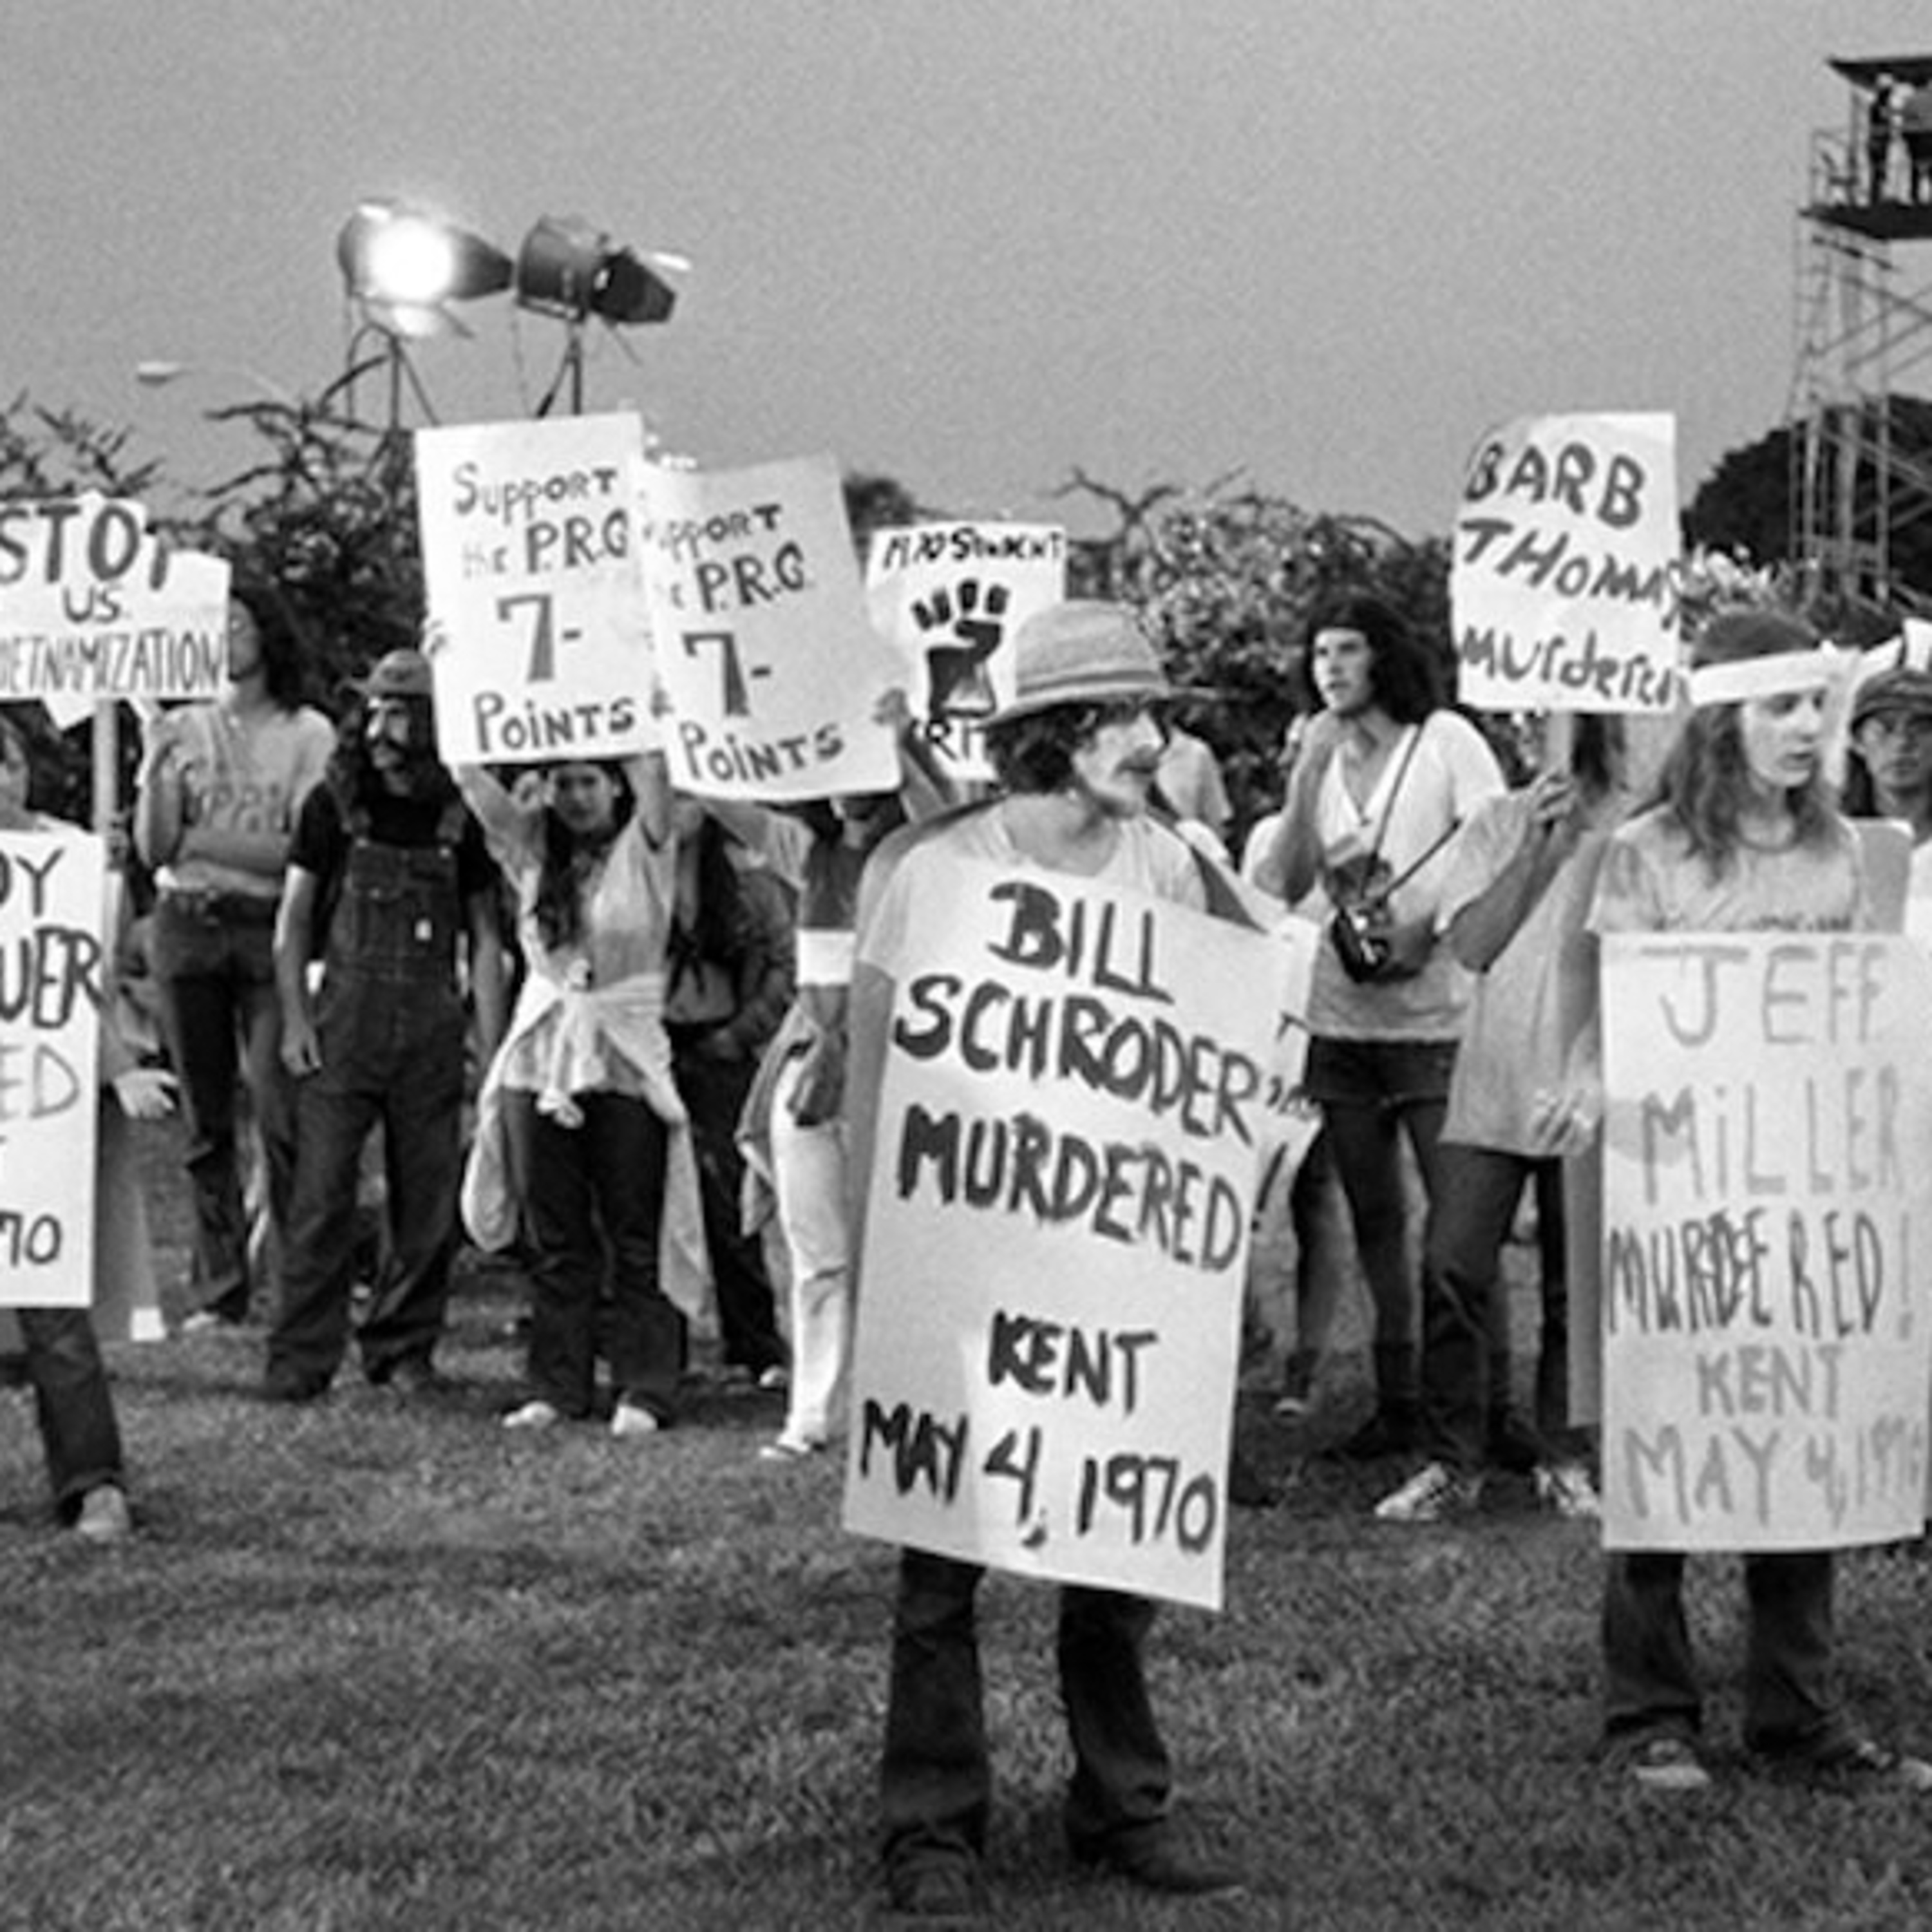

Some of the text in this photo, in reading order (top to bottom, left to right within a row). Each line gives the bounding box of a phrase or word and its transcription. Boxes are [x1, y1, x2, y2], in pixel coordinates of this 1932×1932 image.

[1464, 442, 1645, 528] BARB
[63, 585, 120, 623] US
[987, 881, 1175, 1005] BILL
[1639, 940, 1887, 1046] JEFF
[894, 974, 1260, 1148] SCHRODER
[987, 1309, 1158, 1416] KENT
[1695, 1343, 1843, 1422] KENT
[861, 1397, 969, 1505] MAY
[1077, 1454, 1217, 1553] 1970
[1622, 1422, 1781, 1528] MAY
